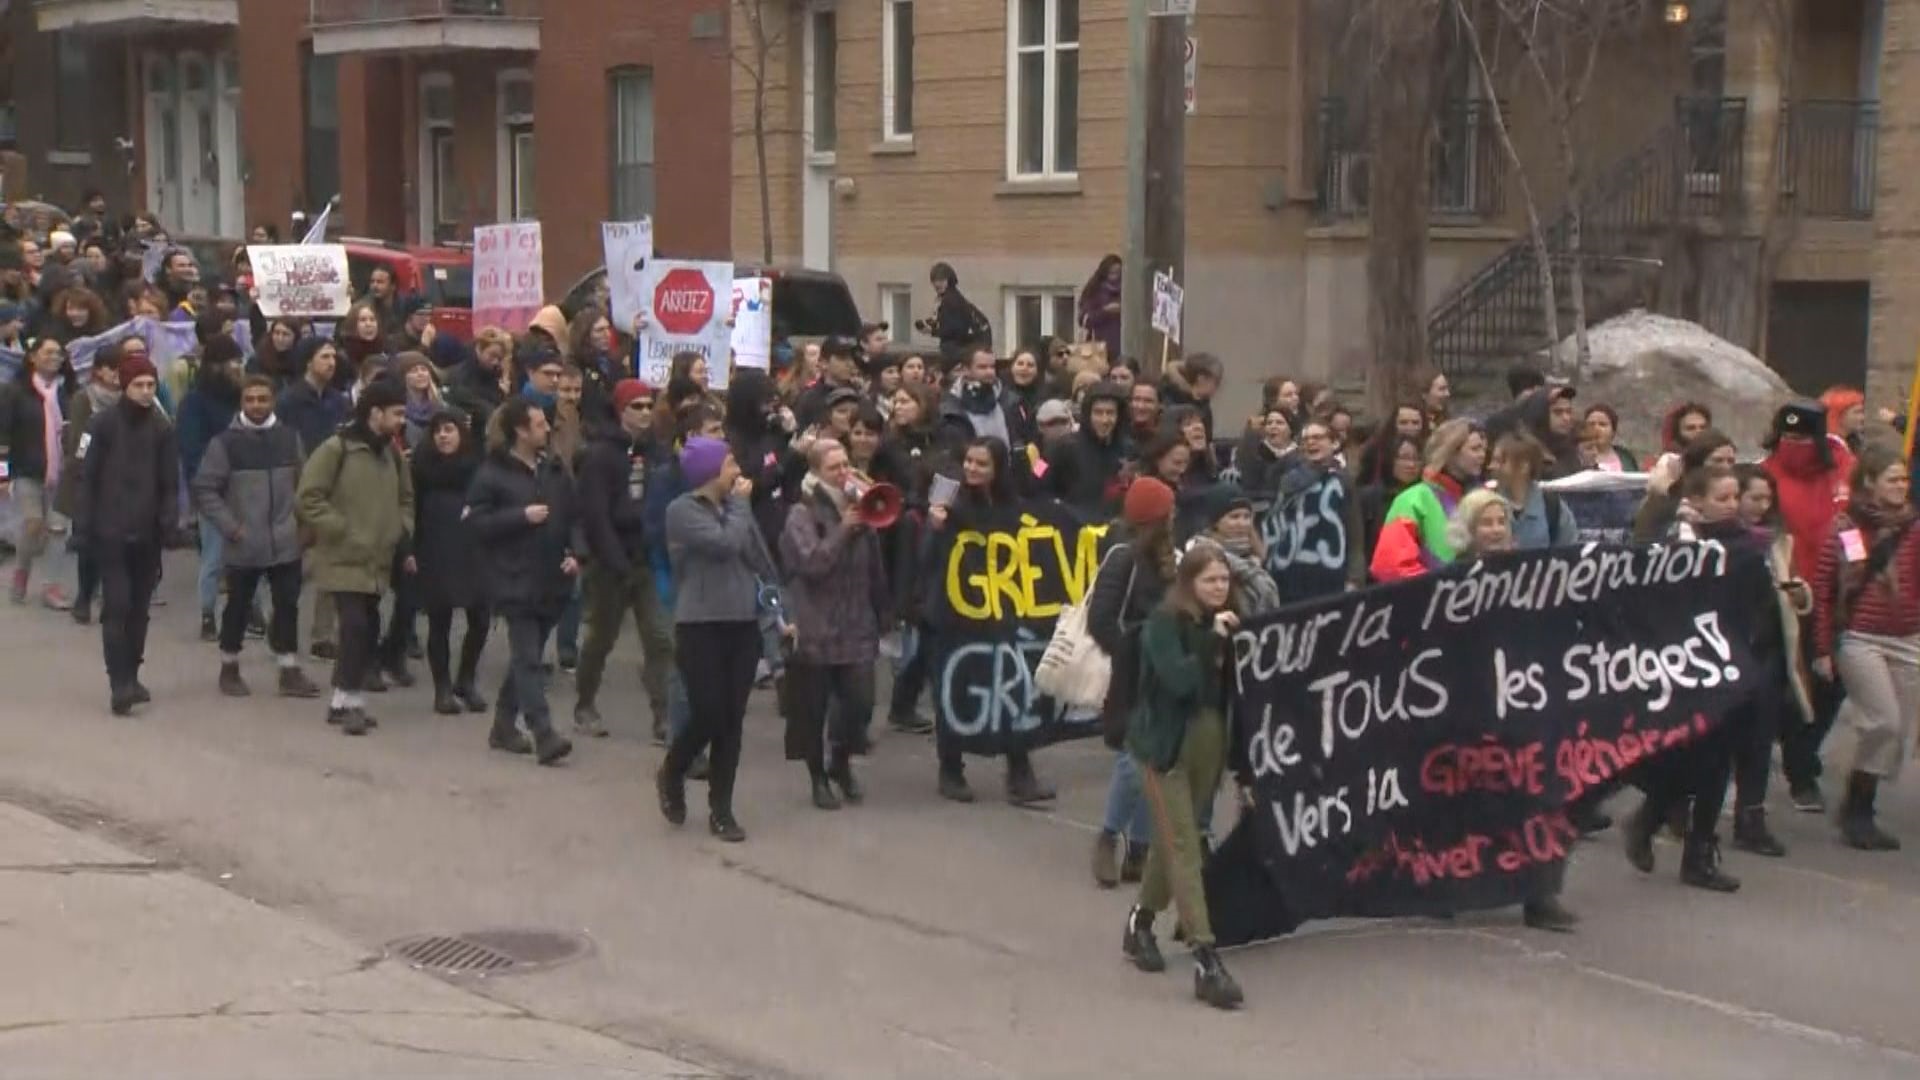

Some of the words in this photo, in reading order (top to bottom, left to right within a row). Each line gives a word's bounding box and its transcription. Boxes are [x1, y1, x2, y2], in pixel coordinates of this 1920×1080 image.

[1338, 601, 1394, 657] la
[1421, 539, 1726, 631] rémunération
[1248, 702, 1302, 778] de
[1493, 647, 1548, 719] les
[1366, 766, 1409, 816] la
[1420, 733, 1545, 796] GRÈVE
